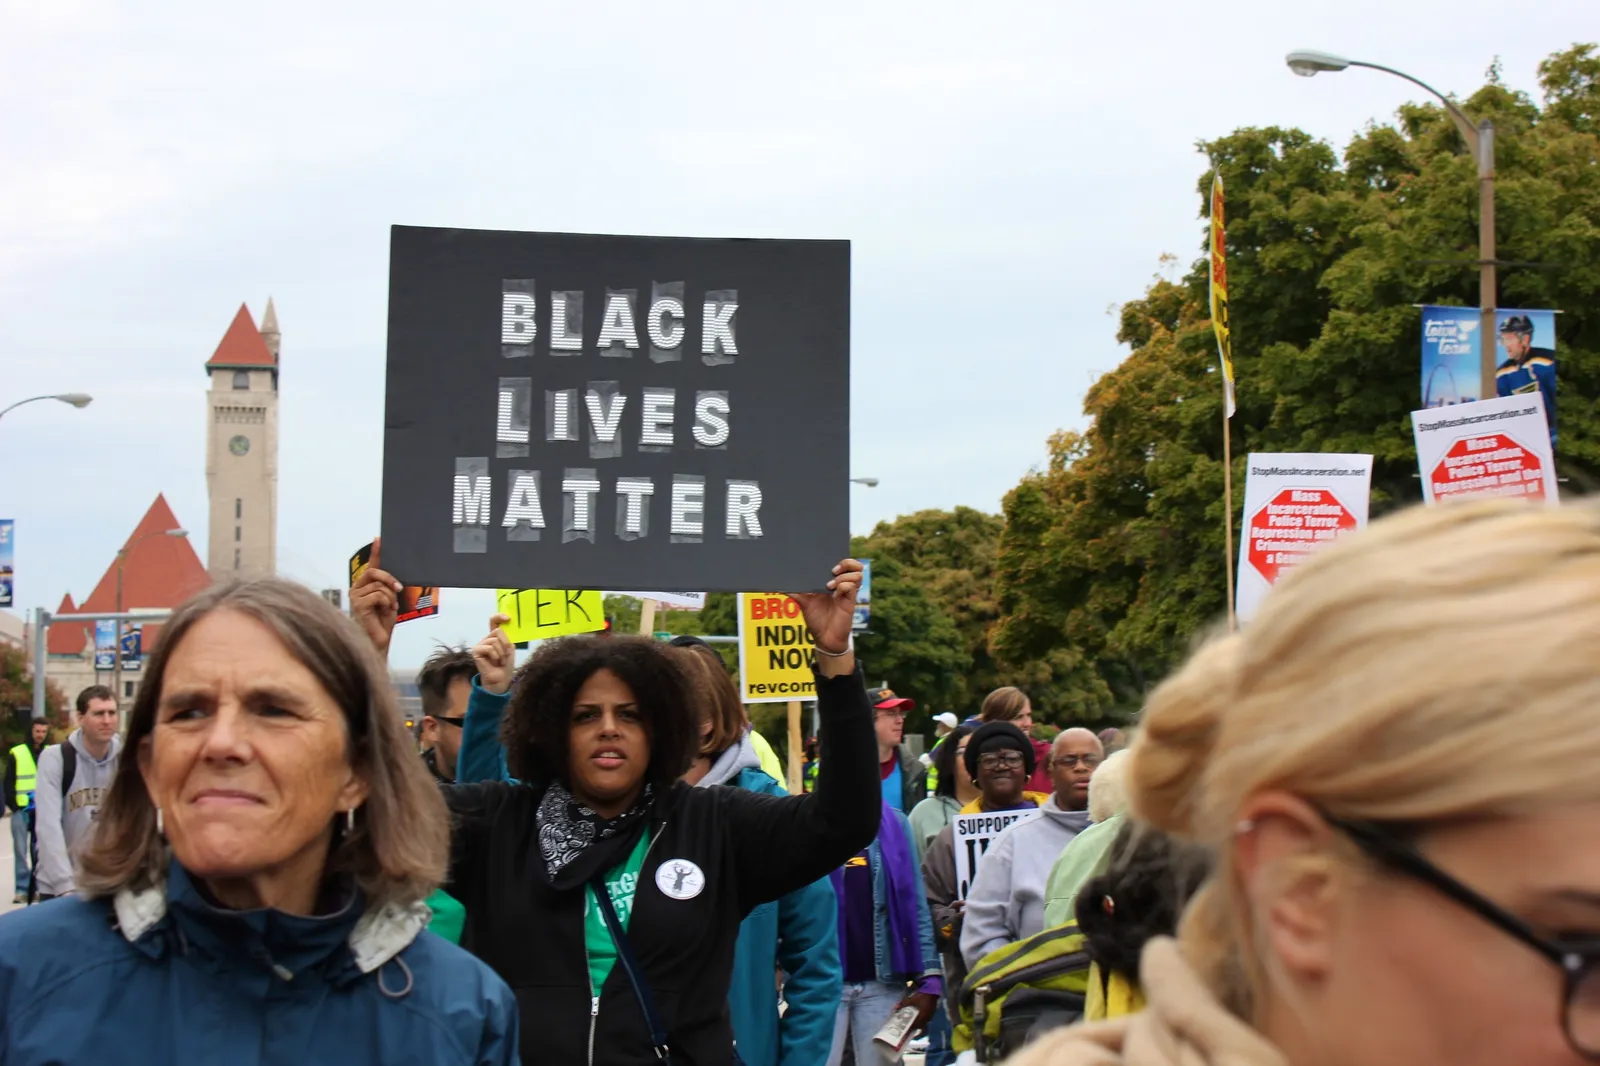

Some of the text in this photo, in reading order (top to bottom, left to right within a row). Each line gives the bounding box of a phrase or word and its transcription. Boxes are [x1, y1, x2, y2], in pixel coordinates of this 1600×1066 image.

[501, 293, 739, 355] BLACK
[496, 391, 730, 447] LIVES
[1251, 467, 1366, 477] StopMassIncarceration.net
[452, 475, 763, 538] MATTER
[1291, 490, 1322, 502] Mass
[1268, 515, 1303, 527] Police
[498, 589, 593, 630] TER
[750, 598, 800, 620] BRO
[749, 681, 818, 694] revcom
